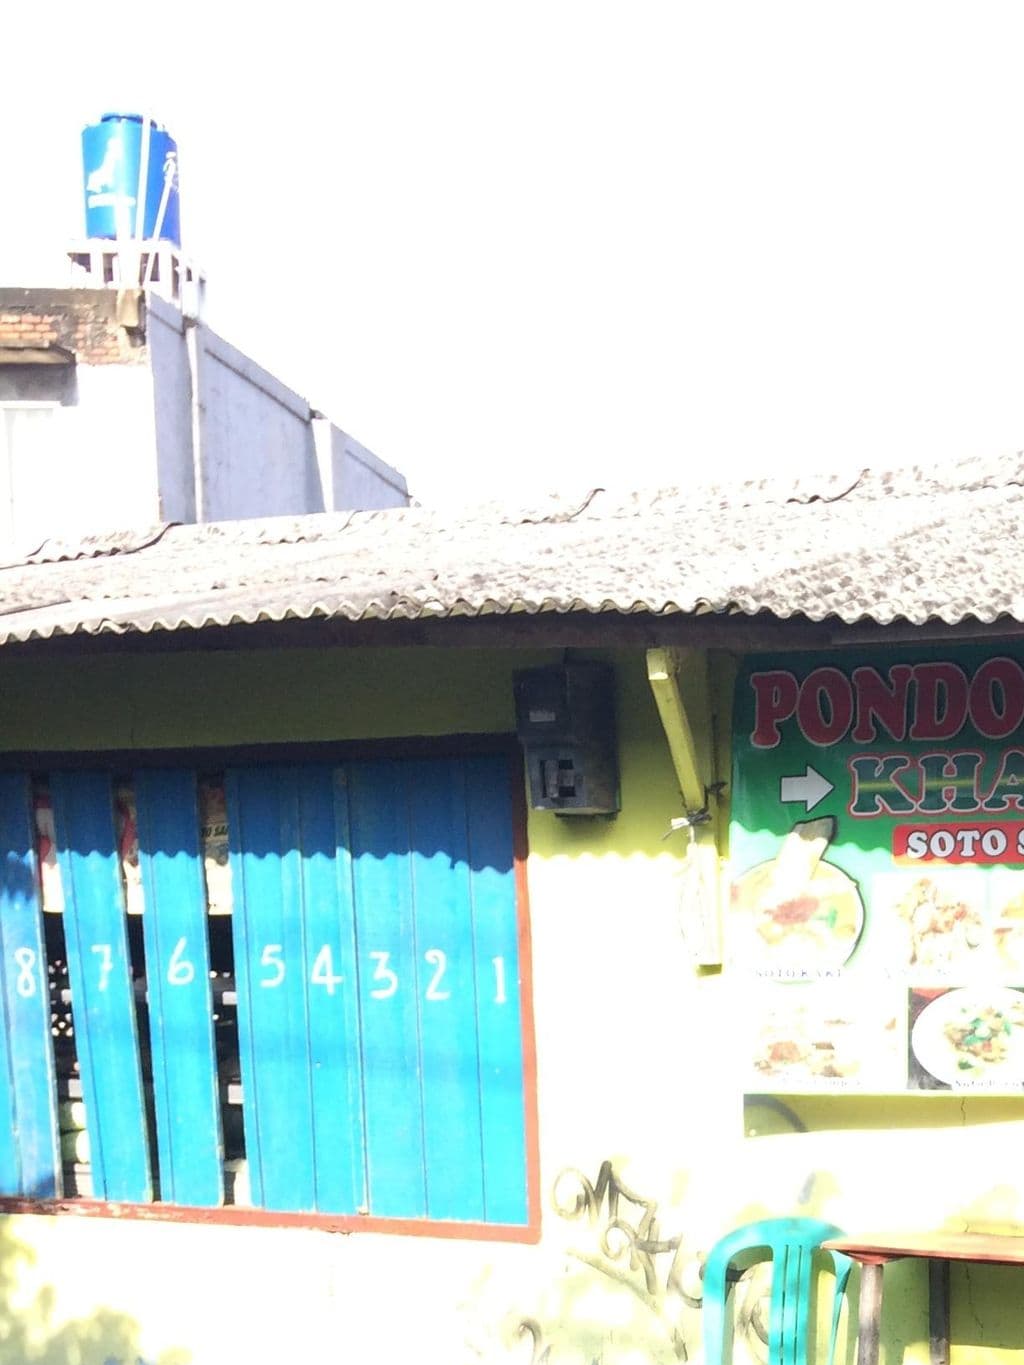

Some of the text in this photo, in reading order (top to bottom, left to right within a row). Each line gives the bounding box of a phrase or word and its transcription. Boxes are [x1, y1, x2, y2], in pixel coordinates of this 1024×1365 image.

[906, 828, 1007, 860] SOTO
[14, 937, 507, 1004] 8 7 6 5 4 3 2 1
